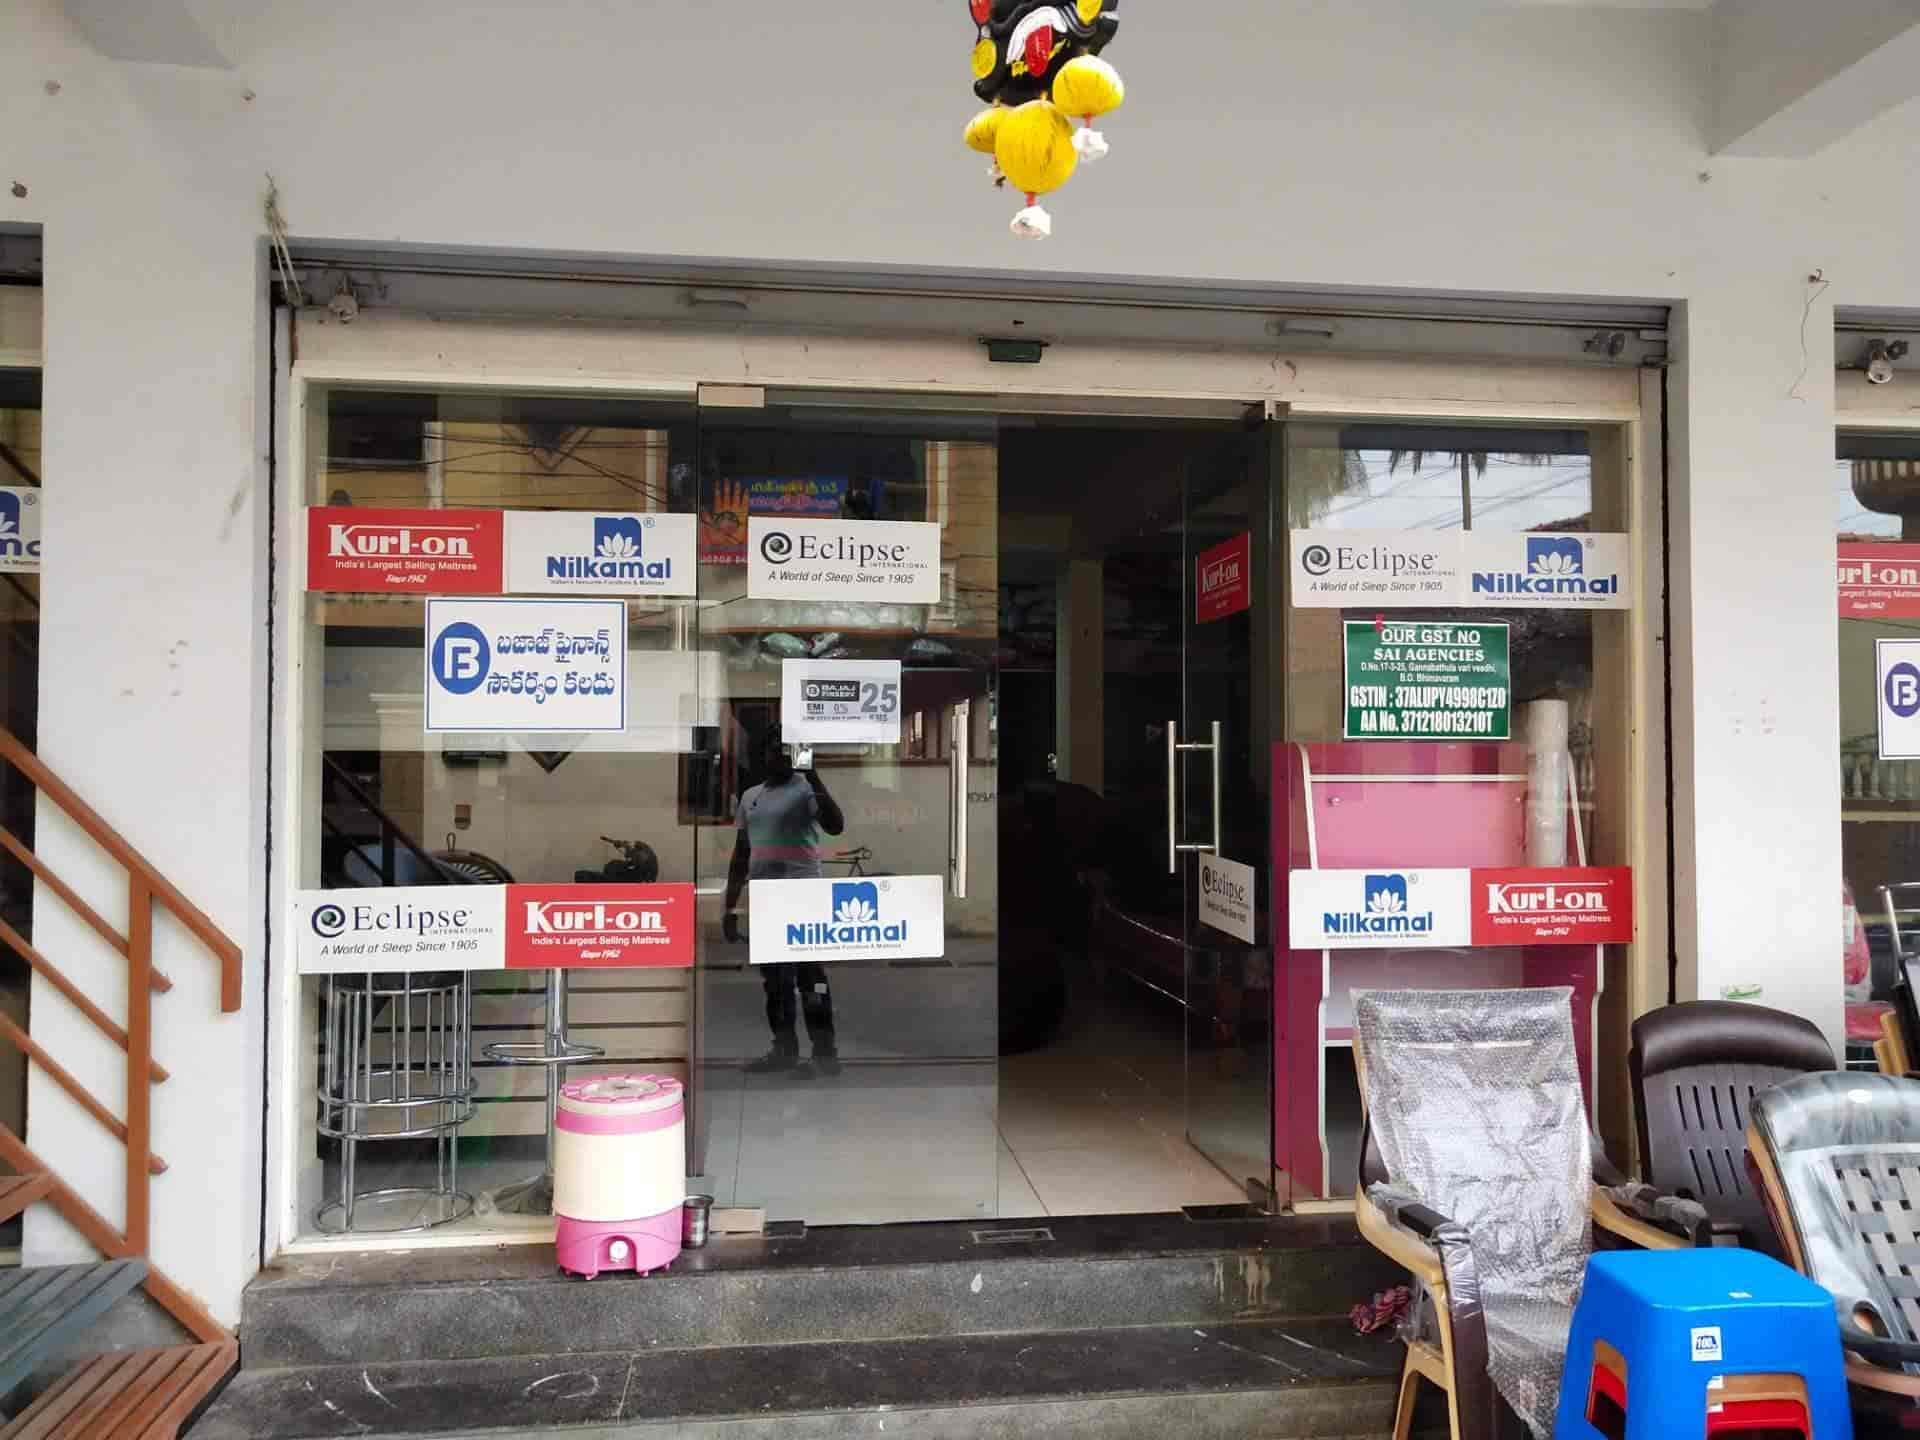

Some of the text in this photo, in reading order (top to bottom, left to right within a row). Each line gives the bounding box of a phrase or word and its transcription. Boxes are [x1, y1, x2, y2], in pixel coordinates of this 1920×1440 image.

[328, 524, 473, 558] Kurl-on
[799, 535, 905, 568] Eclipse
[335, 560, 365, 569] India's
[367, 560, 402, 571] Largest
[405, 560, 435, 571] Selling
[547, 556, 671, 578] Nilkamal
[1336, 547, 1434, 576] Eclipse
[768, 570, 914, 584] A World of Sleep Since 1905
[1309, 581, 1443, 592] A World of Sleep Since 1905
[1472, 573, 1617, 593] Nilkamal
[496, 628, 554, 654] బజాజ్
[1381, 629, 1481, 643] OUR GST NO
[1374, 648, 1485, 662] SAI AGENCIES
[807, 703, 824, 711] EMI
[861, 683, 897, 712] 25
[1351, 686, 1387, 707] GSTIN
[1360, 711, 1377, 732] AA
[1380, 711, 1399, 732] No.
[1486, 883, 1608, 913] Kurl-on
[353, 903, 468, 935] Eclipse
[524, 901, 667, 933] Kurl-on
[1323, 912, 1433, 933] Nilkamal
[531, 935, 670, 946] India's Largest Selling Mattress
[786, 920, 907, 945] Nilkamal
[320, 939, 478, 955] A World of Sleep Since 1905
